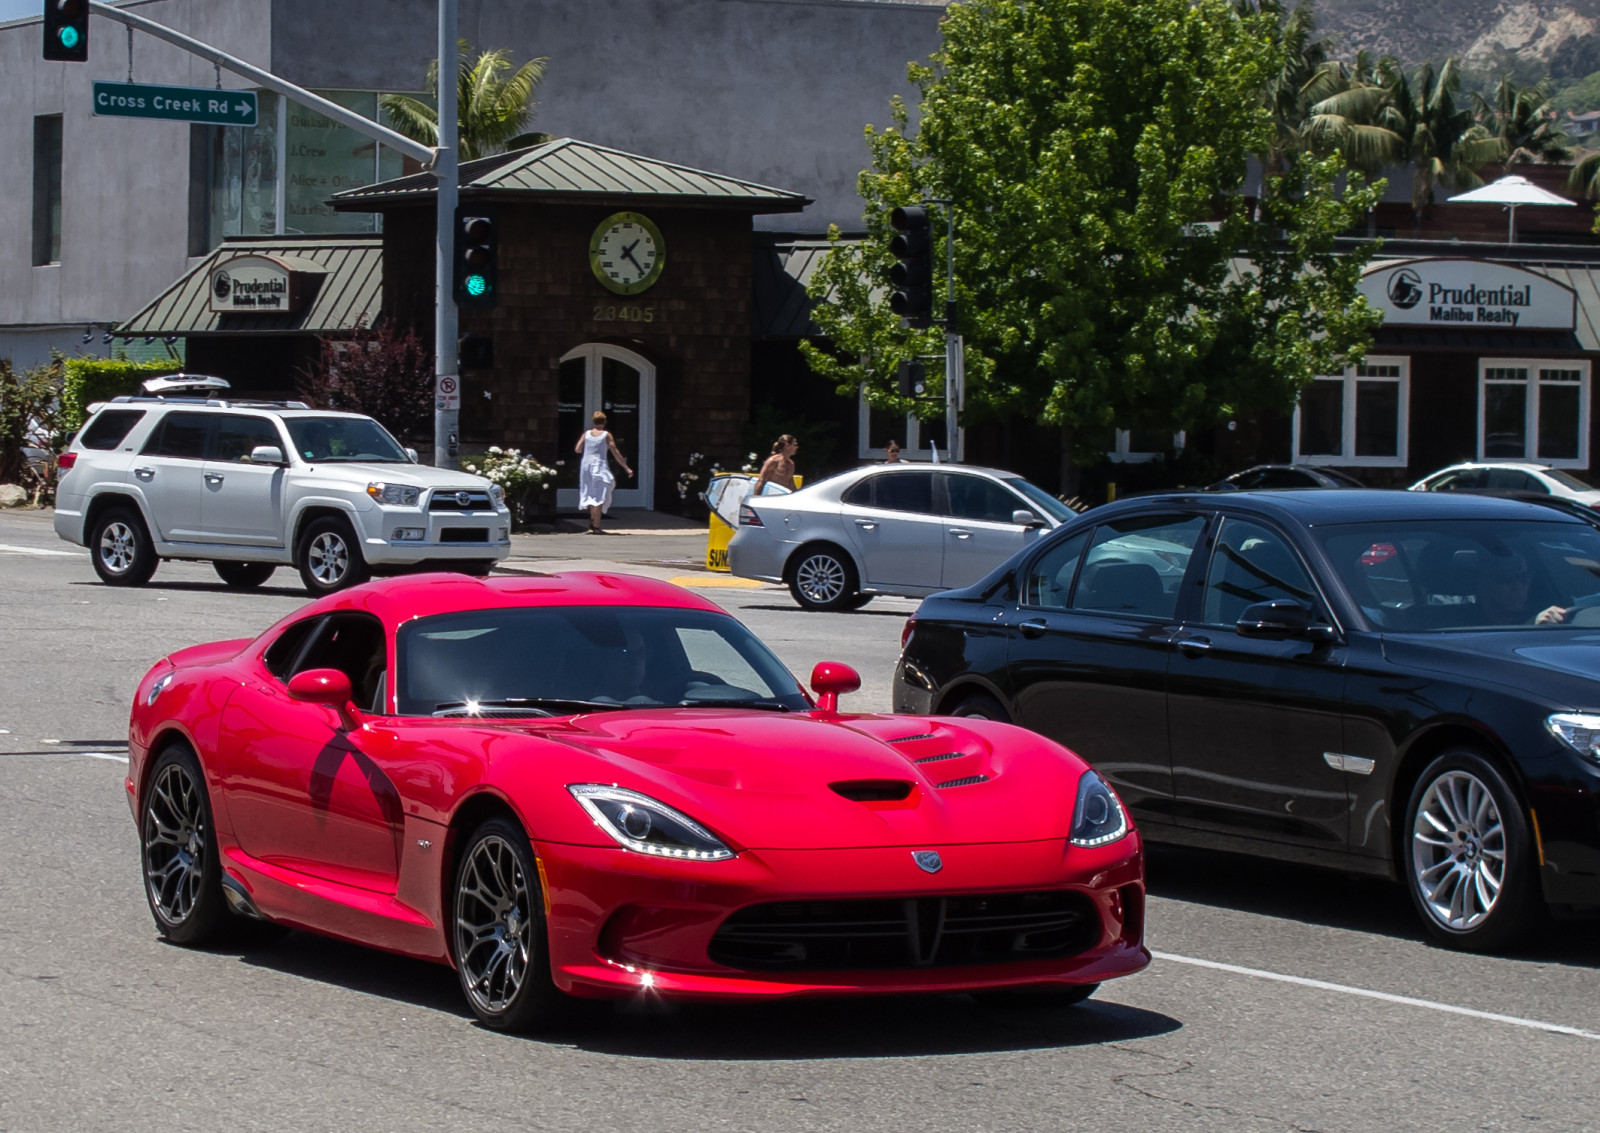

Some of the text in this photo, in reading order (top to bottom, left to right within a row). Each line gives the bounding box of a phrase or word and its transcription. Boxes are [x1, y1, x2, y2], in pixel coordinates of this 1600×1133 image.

[97, 92, 228, 114] Cross Creek Rd
[232, 277, 287, 294] Prudential
[1428, 282, 1531, 307] Prudential
[593, 305, 655, 323] 23405
[1429, 306, 1519, 327] Malibu Realty
